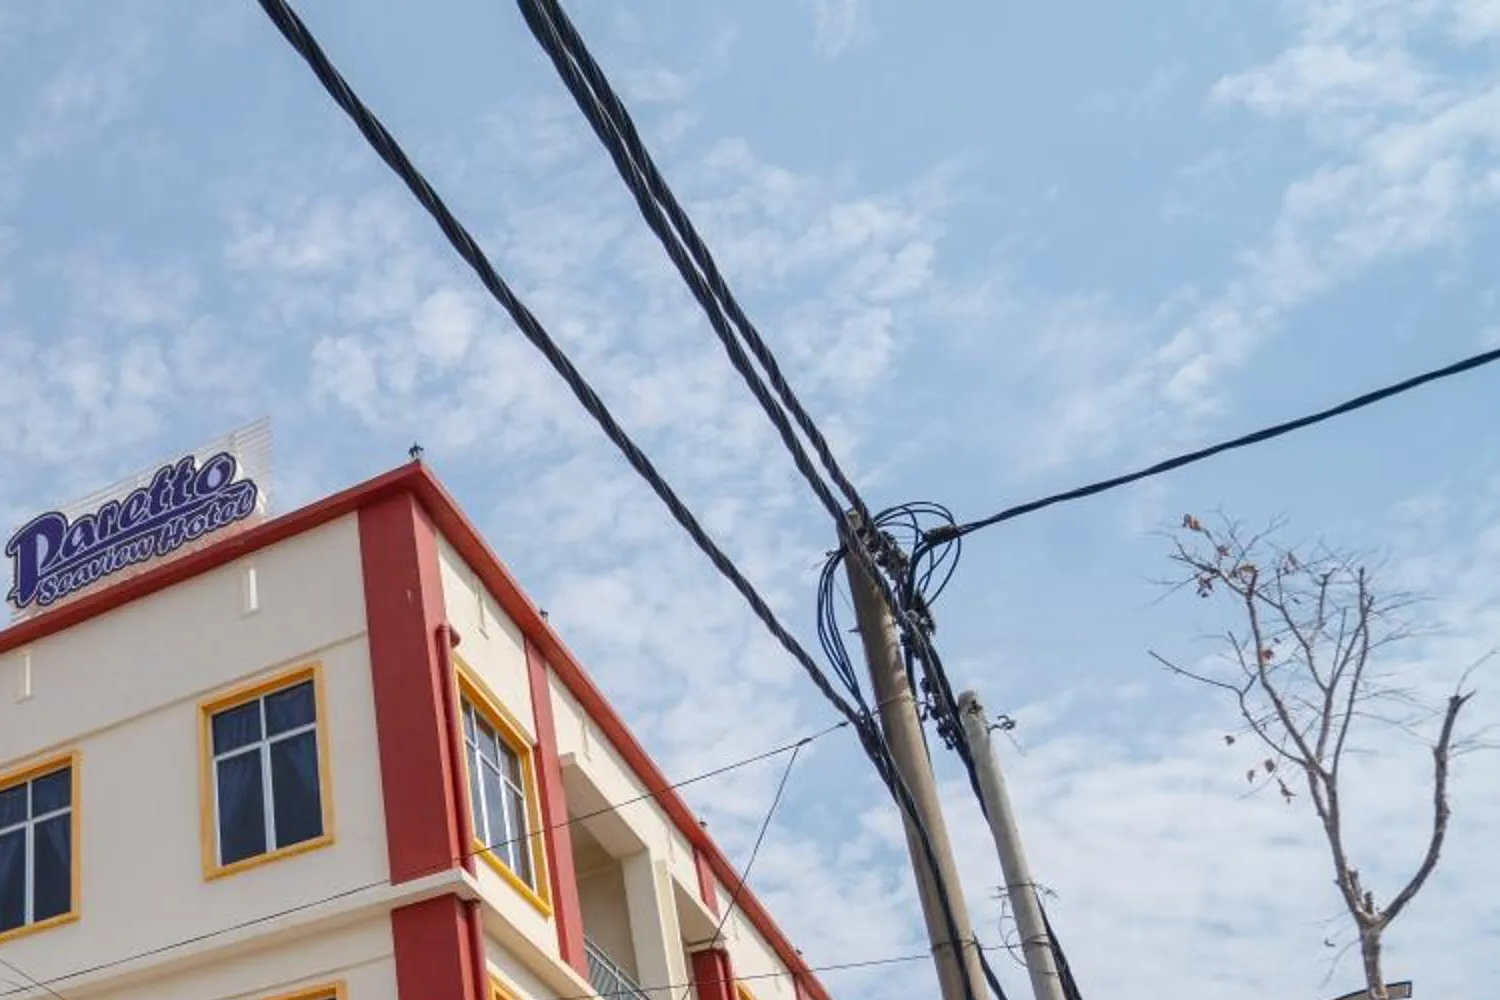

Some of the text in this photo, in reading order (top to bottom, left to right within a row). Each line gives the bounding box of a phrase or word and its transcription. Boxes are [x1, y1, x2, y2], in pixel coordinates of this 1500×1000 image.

[6, 452, 237, 608] Paretto
[37, 478, 257, 606] Seaview Hotel
